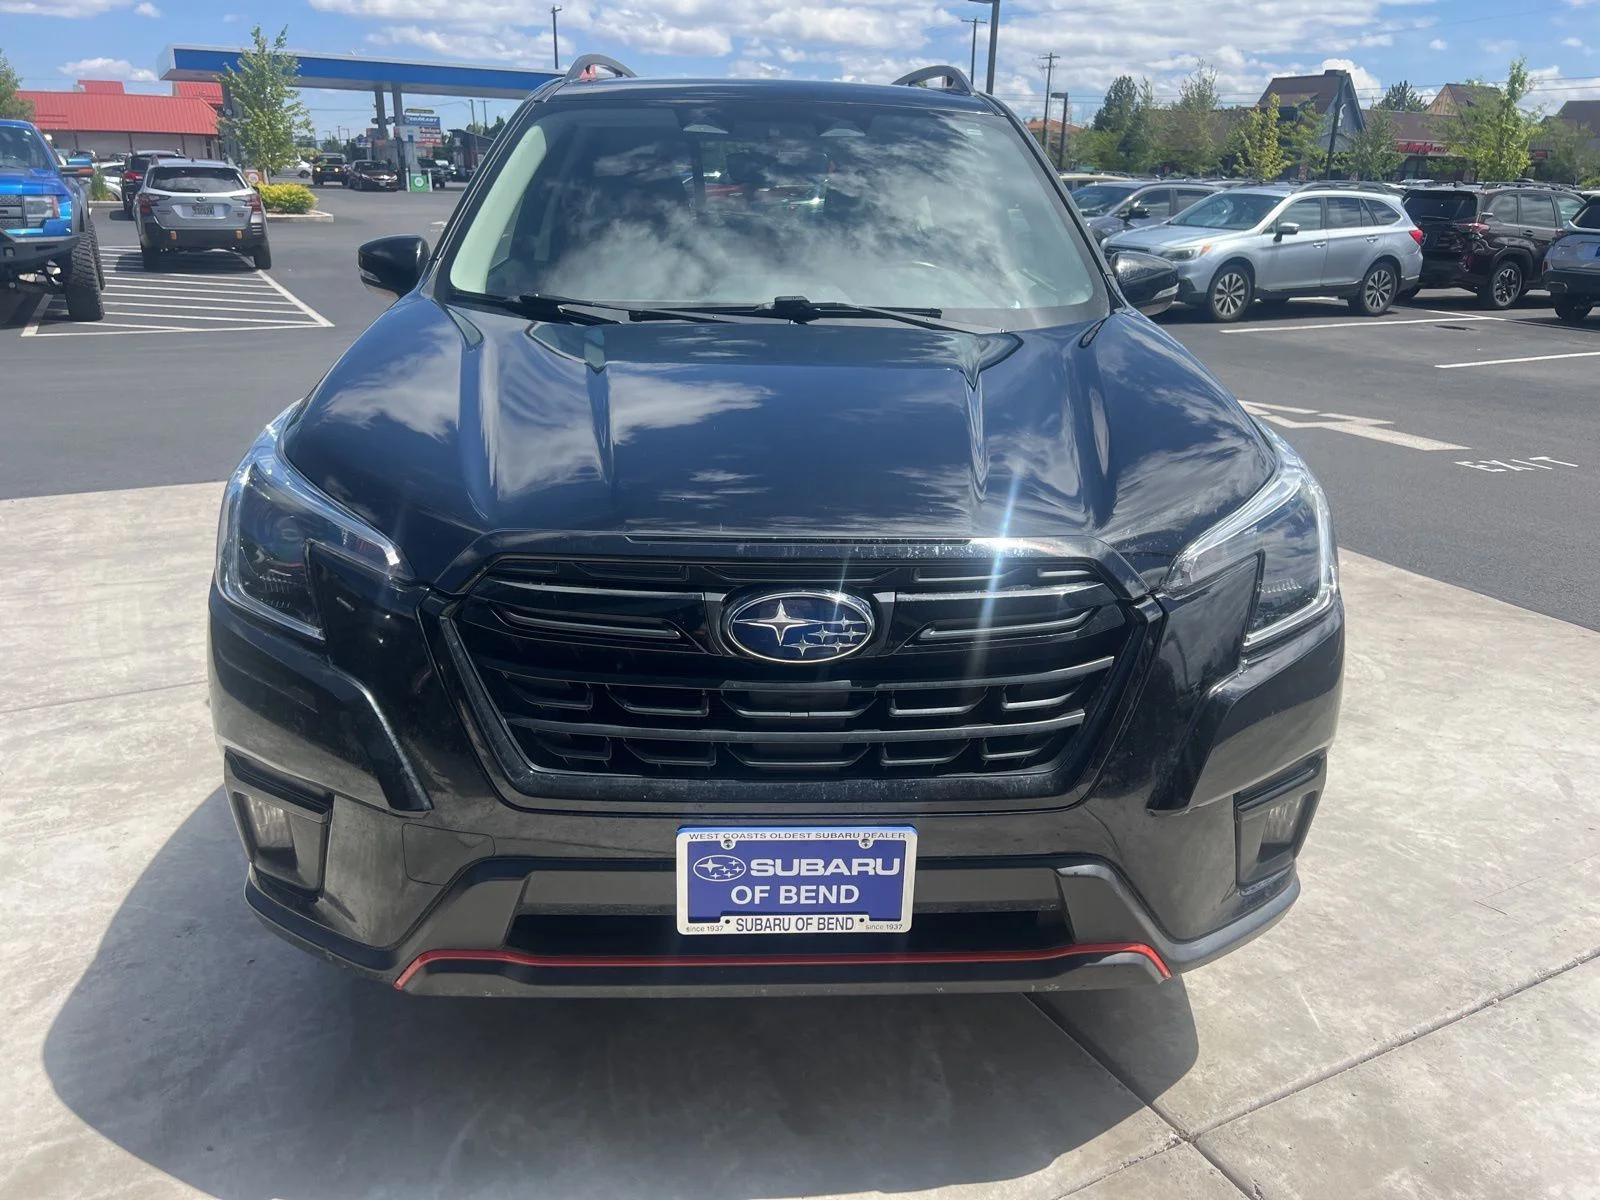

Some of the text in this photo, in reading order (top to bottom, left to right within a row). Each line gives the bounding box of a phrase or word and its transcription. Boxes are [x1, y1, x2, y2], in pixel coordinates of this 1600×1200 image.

[1453, 456, 1579, 473] EXIT
[750, 858, 901, 876] SUBARU
[730, 884, 860, 905] OF BEND
[735, 916, 855, 932] SUBARU OF BEND
